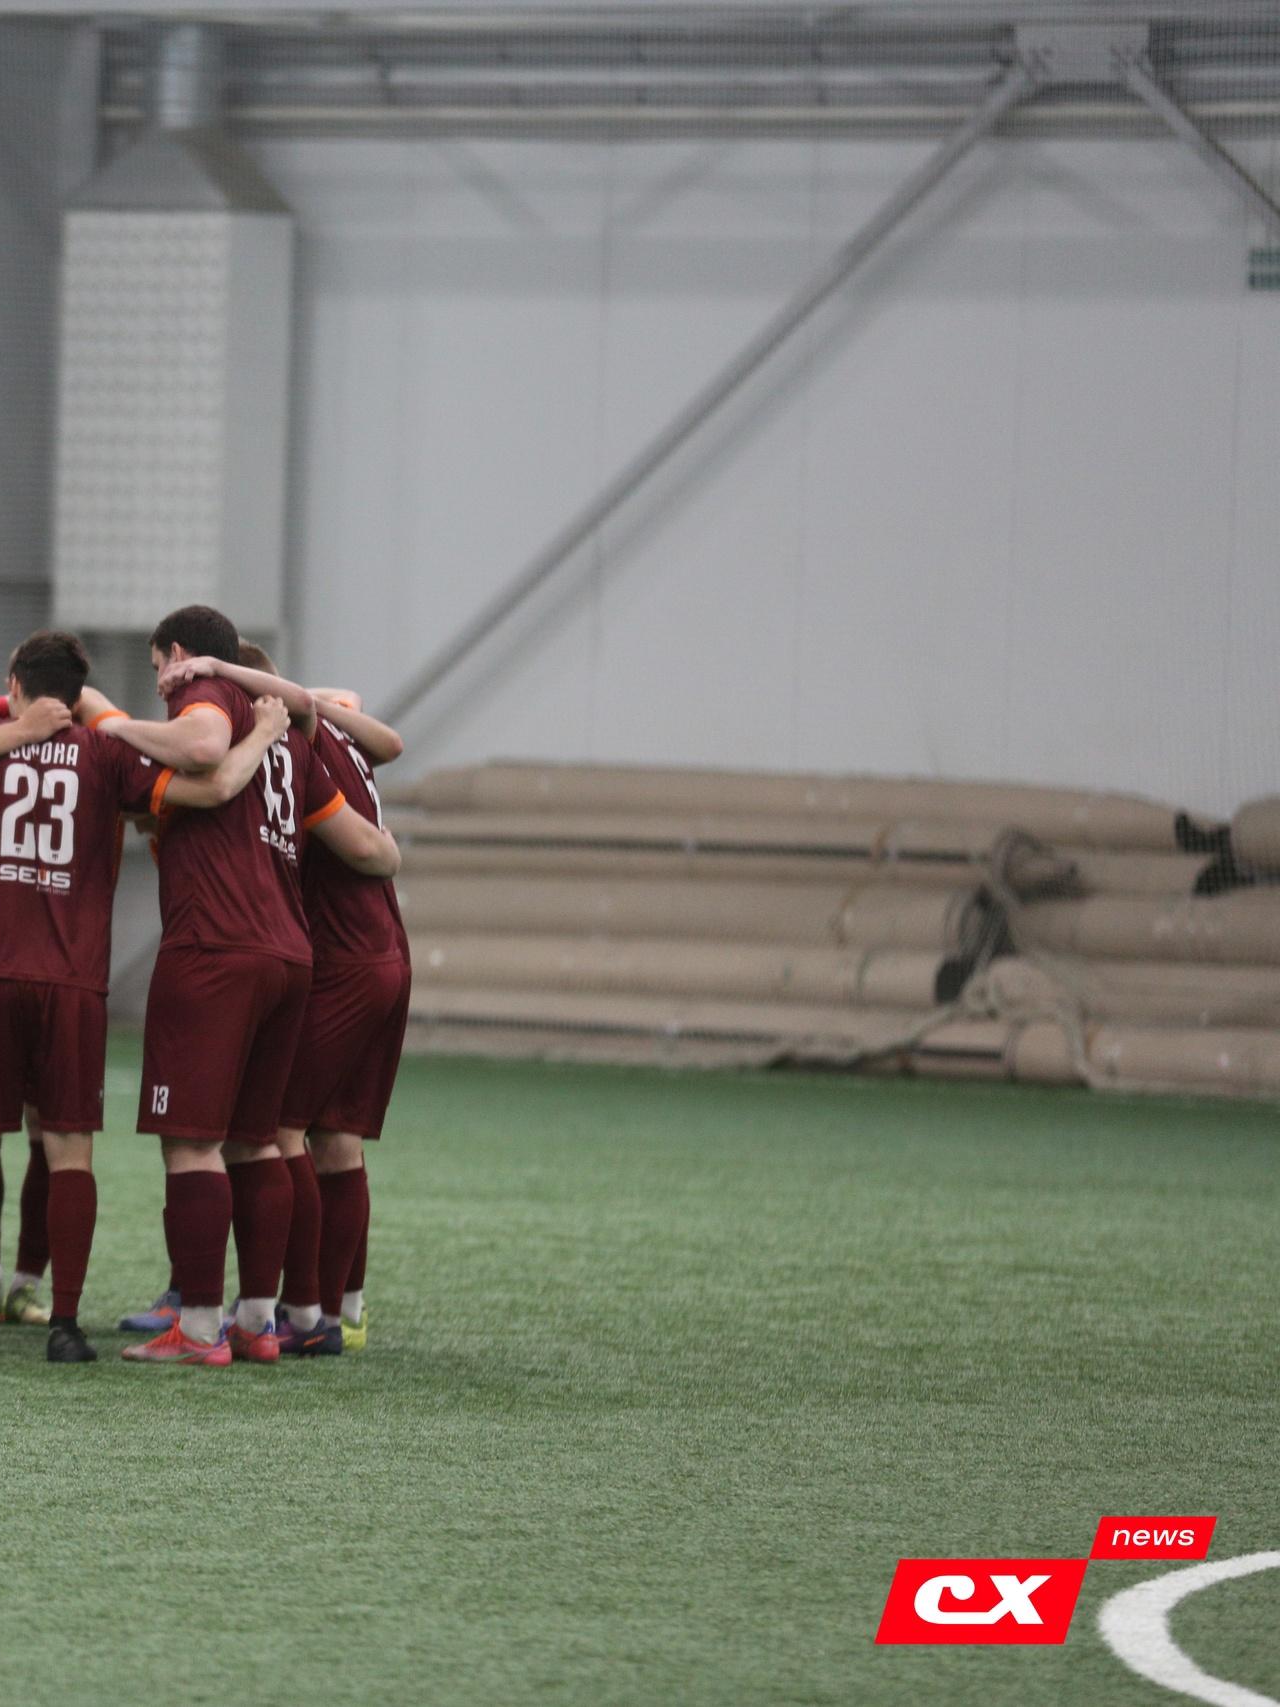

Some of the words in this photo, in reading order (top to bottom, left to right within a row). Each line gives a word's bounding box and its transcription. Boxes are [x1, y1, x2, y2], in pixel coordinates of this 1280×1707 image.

[0, 763, 80, 865] 23
[0, 864, 71, 889] SEUS
[151, 1085, 169, 1115] 13
